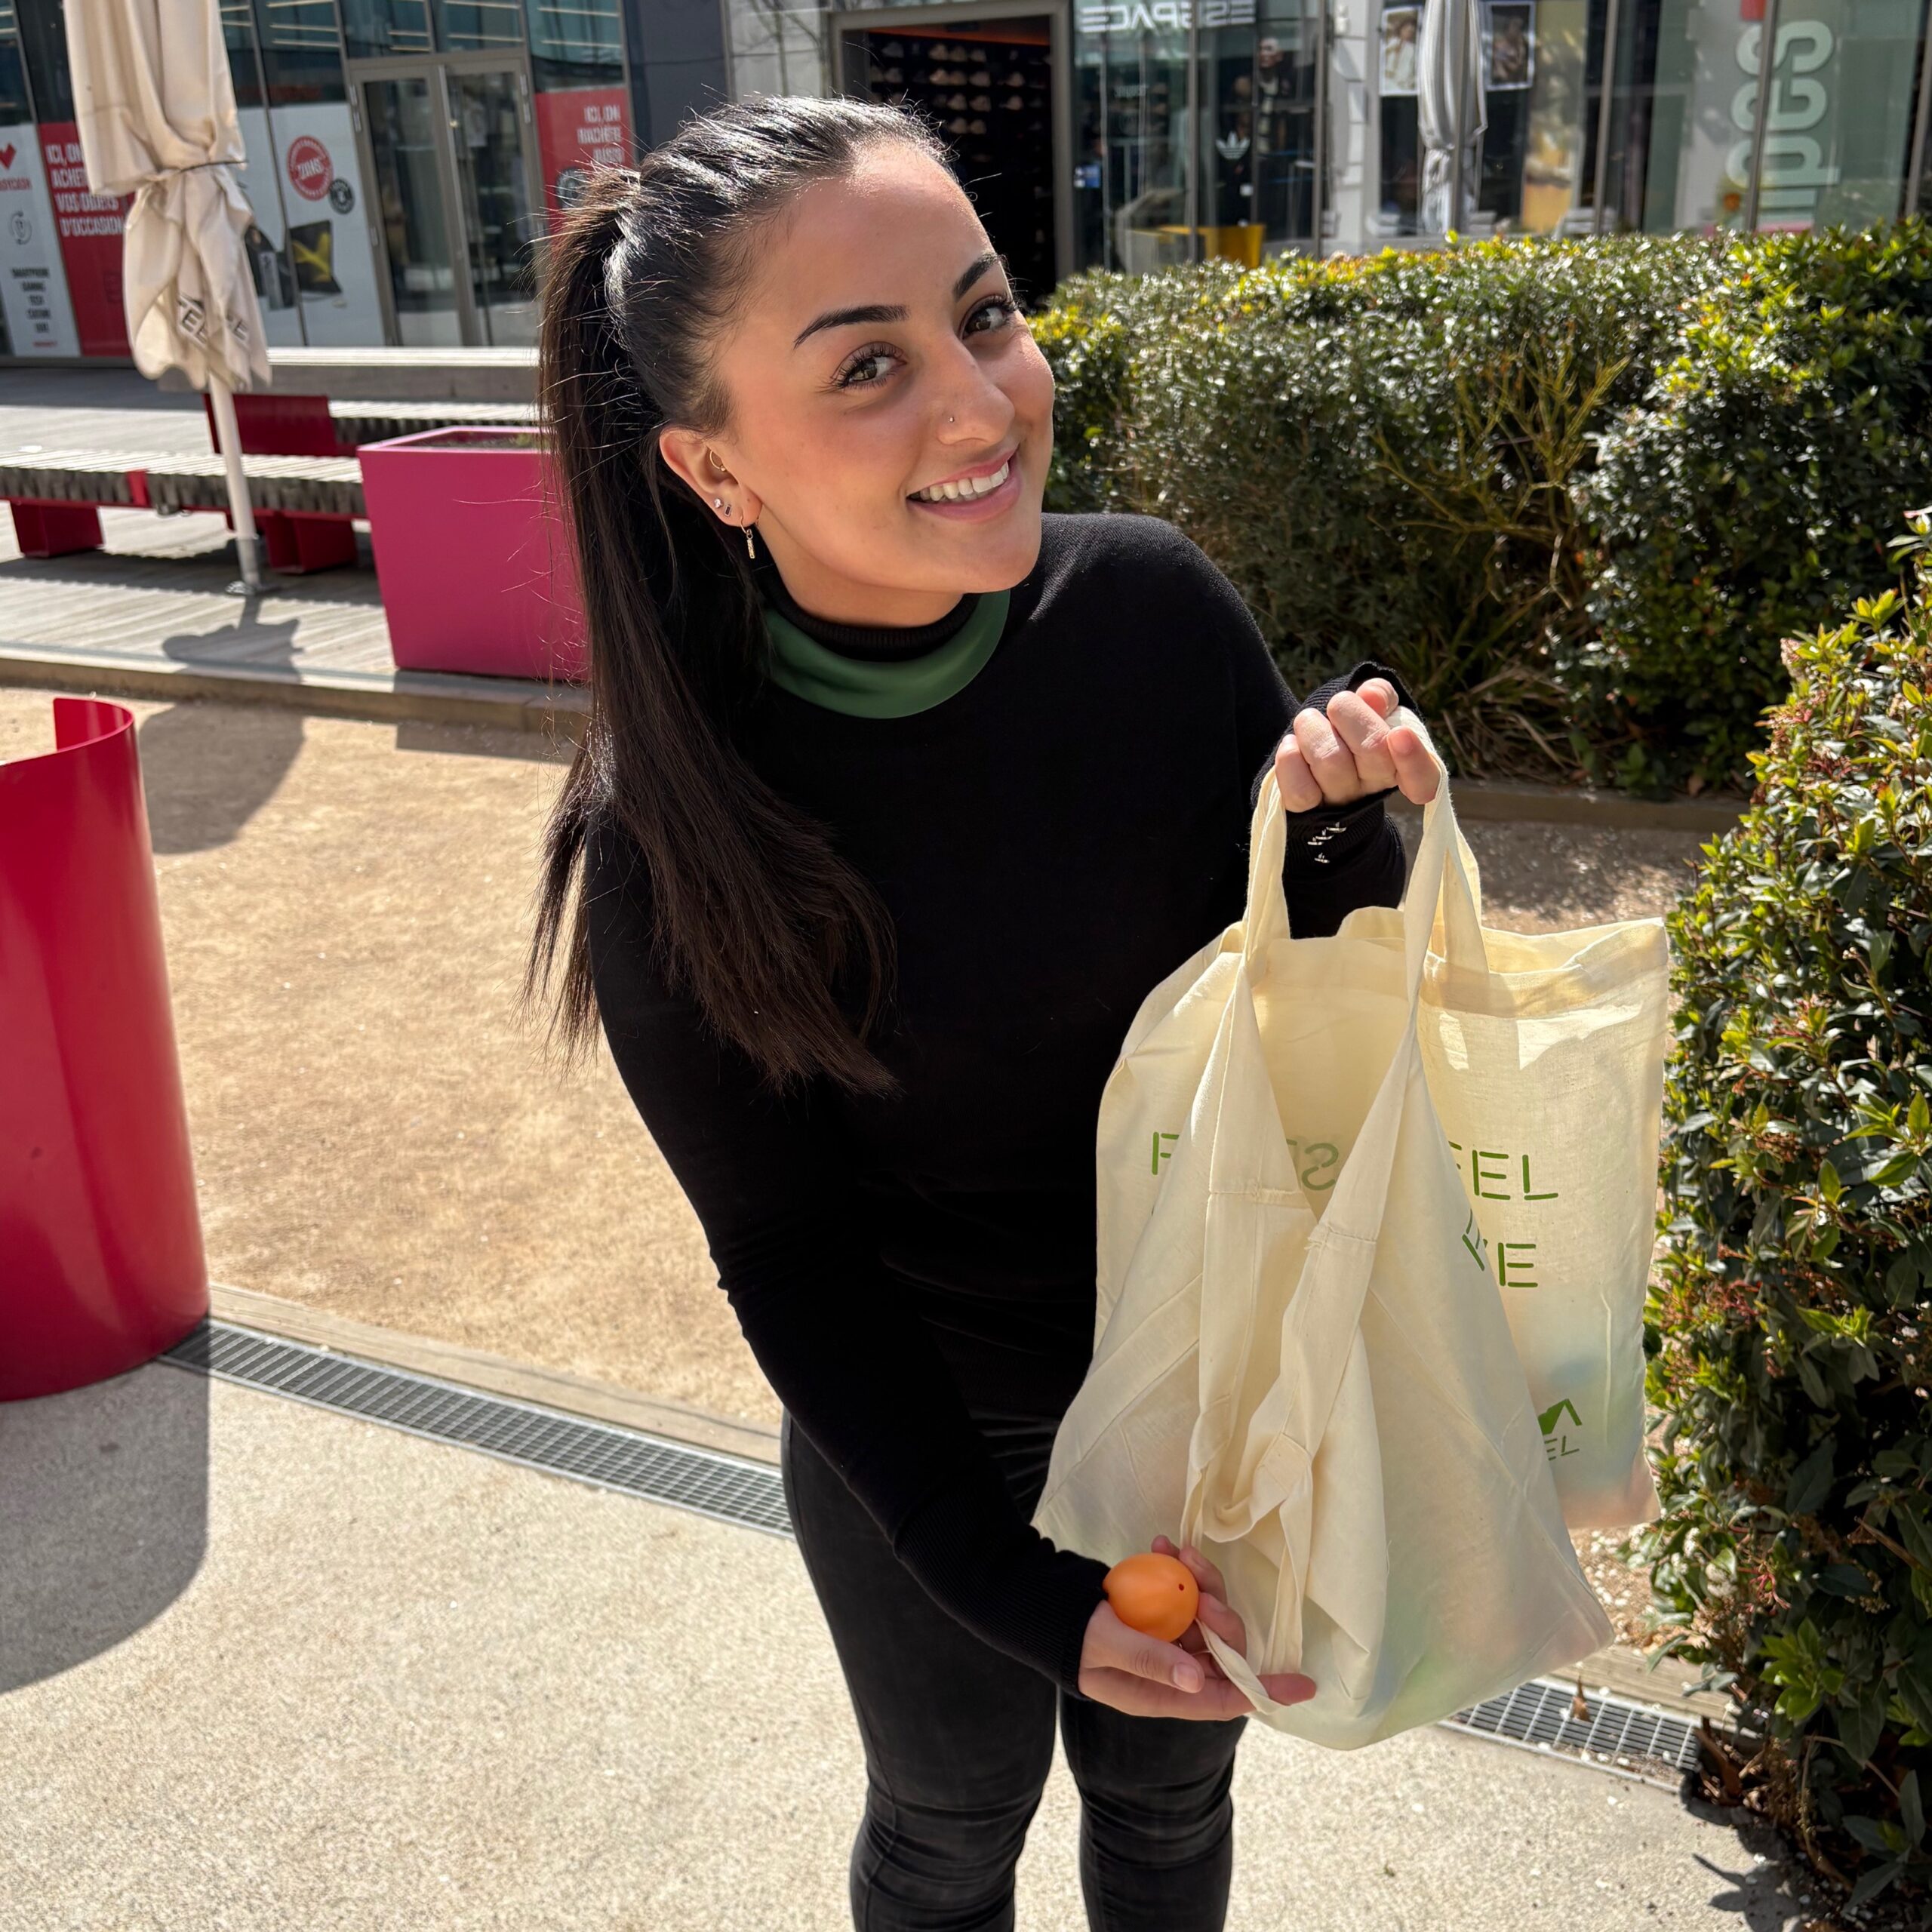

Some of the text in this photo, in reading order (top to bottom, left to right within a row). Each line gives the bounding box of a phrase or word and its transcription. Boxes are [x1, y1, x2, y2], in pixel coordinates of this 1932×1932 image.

[45, 143, 67, 166] ICI,
[55, 192, 80, 212] VOS
[59, 215, 123, 237] D'OCCASION
